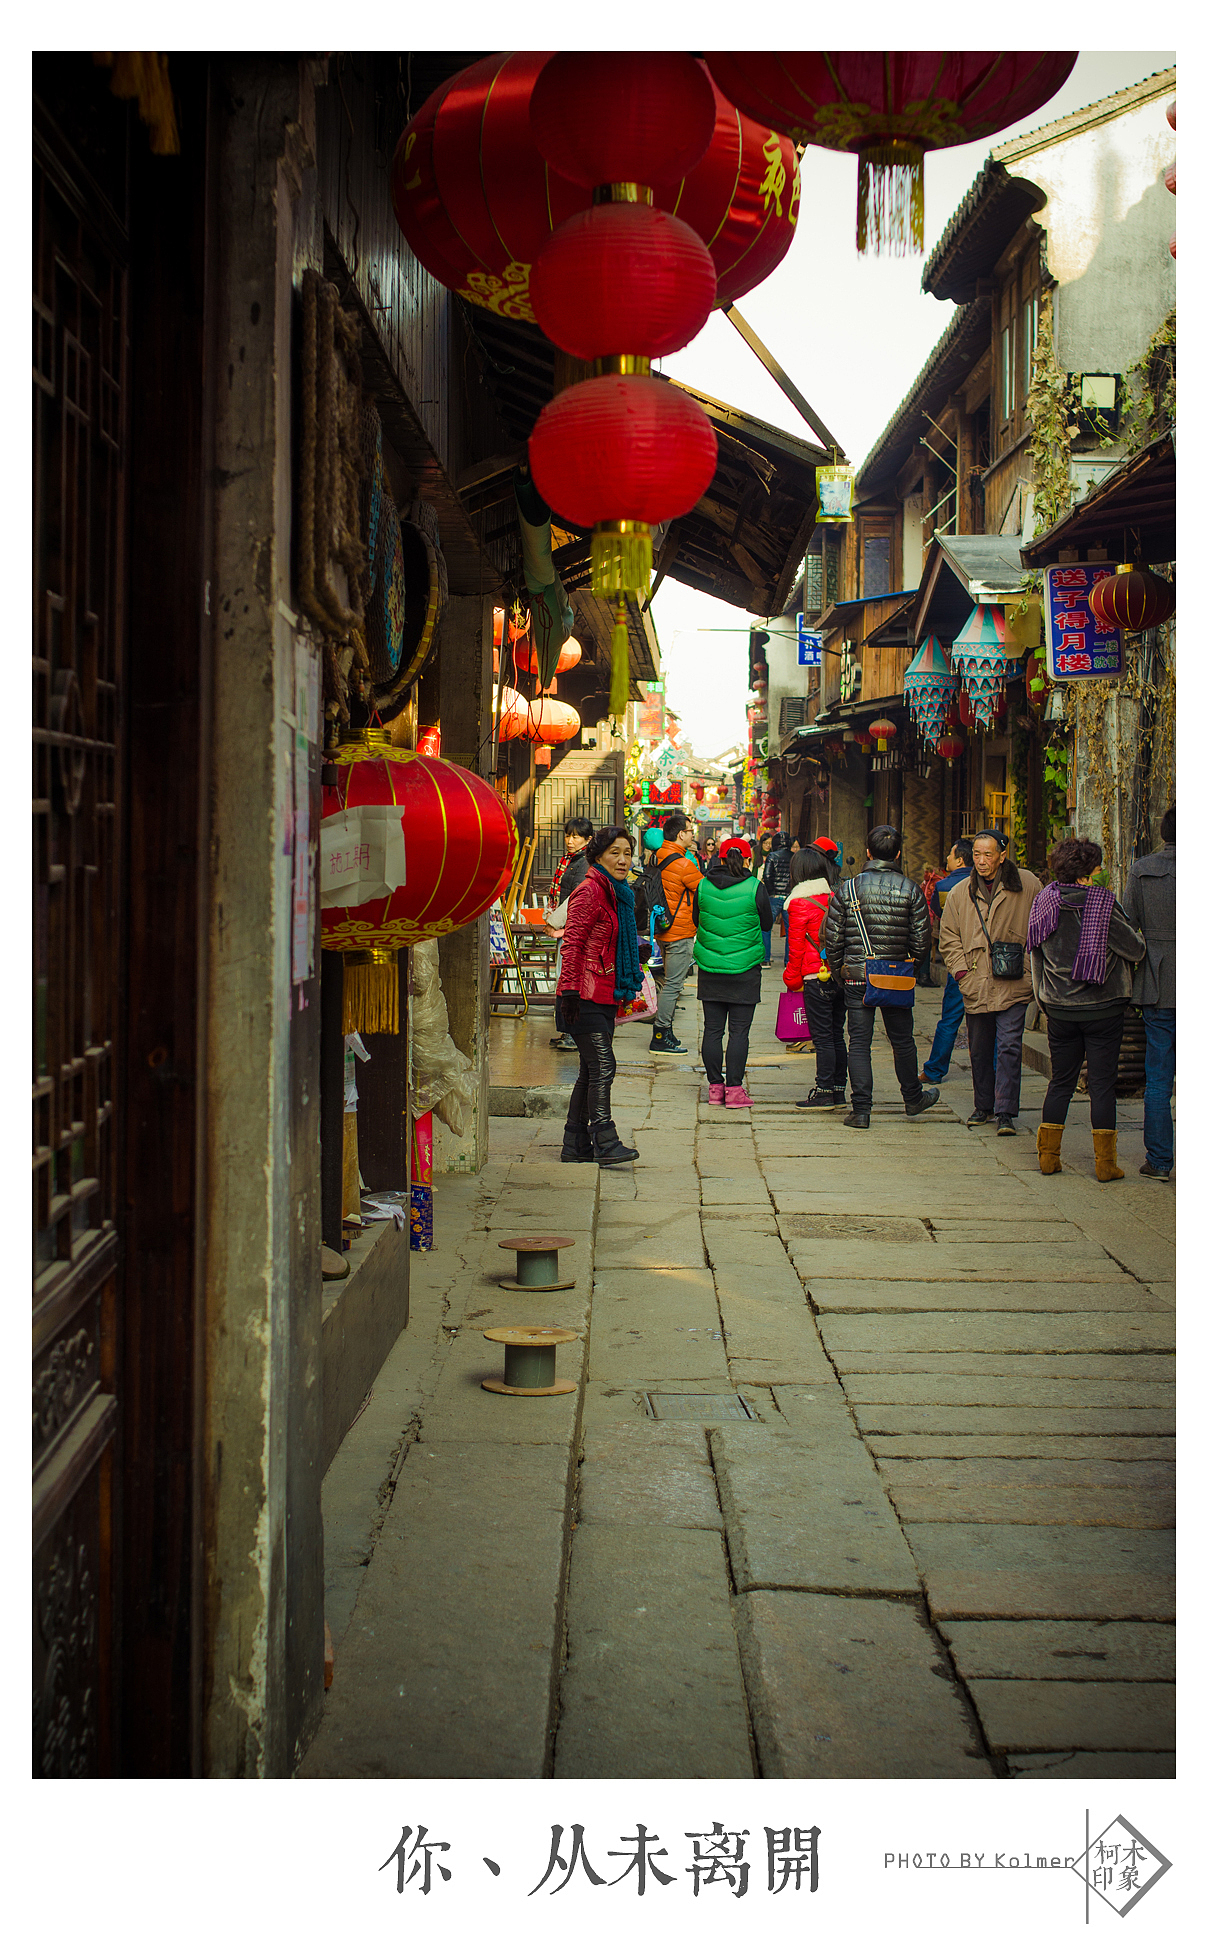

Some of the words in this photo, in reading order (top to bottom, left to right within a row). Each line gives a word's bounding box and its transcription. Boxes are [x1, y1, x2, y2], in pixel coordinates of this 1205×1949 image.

[1092, 570, 1115, 634] 农菜
[1052, 569, 1092, 673] 送子得月楼
[1093, 640, 1118, 652] 二楼
[1093, 655, 1119, 668] 就餐
[658, 746, 676, 767] 茶
[329, 843, 370, 875] 施工期
